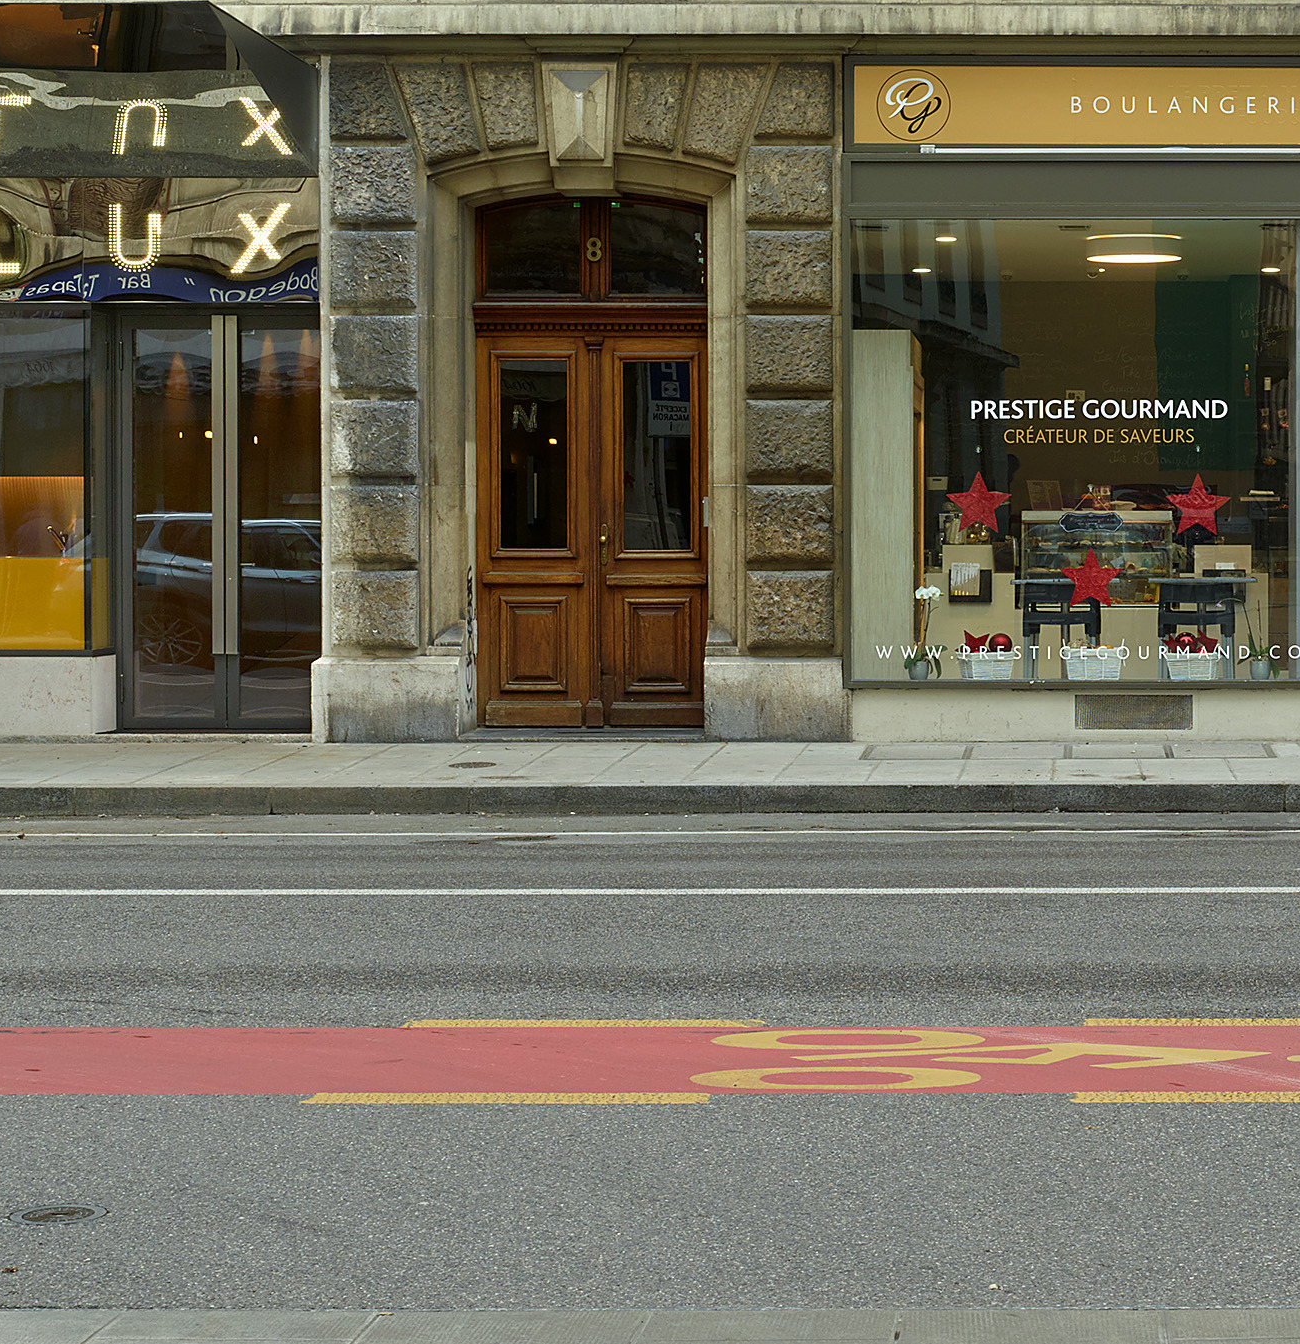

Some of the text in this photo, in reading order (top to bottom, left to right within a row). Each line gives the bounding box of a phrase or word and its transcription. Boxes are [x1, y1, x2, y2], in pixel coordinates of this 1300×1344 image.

[586, 237, 602, 262] 8
[970, 399, 1229, 420] PRESTIGE GOURMAND
[1003, 426, 1195, 444] CRÉATEUR DE SAVEURS
